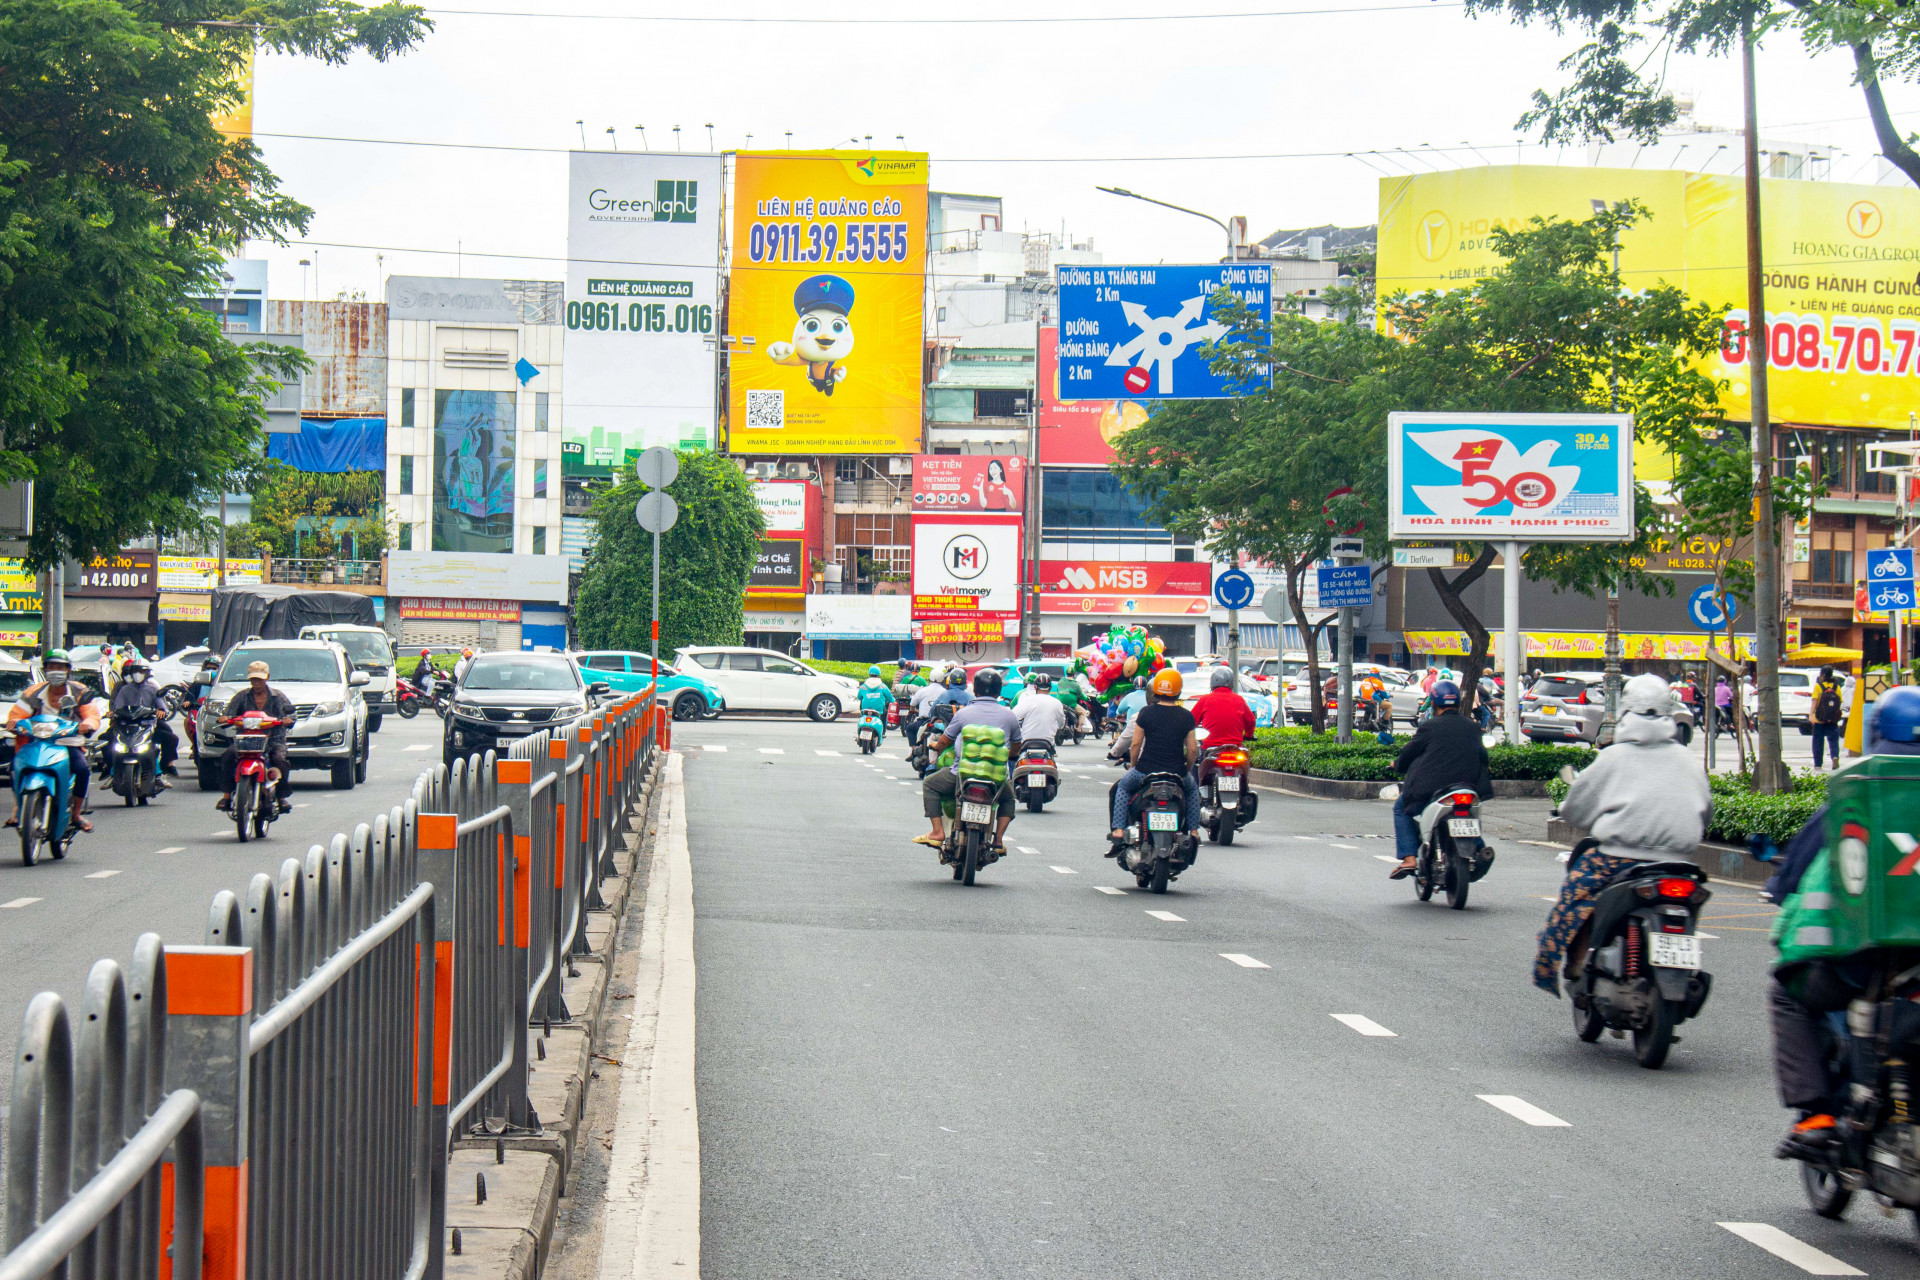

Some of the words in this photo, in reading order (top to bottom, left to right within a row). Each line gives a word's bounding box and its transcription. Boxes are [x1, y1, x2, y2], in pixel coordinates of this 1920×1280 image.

[878, 162, 916, 170] VINAMA
[589, 179, 697, 223] Greenlight
[758, 197, 790, 216] LIÊN
[795, 197, 814, 220] HỆ
[819, 197, 868, 217] QUẢNG
[873, 197, 902, 216] CÁO
[588, 214, 655, 222] ADVERTISING
[750, 223, 908, 263] 0911.39.5555
[1792, 241, 1849, 258] HOANG
[1853, 245, 1879, 260] GIA
[1060, 268, 1091, 286] ĐƯỜNG
[1094, 271, 1106, 286] BA
[1108, 267, 1138, 285] THÁNG
[1140, 270, 1156, 285] HAI
[1221, 266, 1246, 284] CÔNG
[1248, 266, 1269, 284] VIÊN
[1449, 266, 1471, 280] LIÊN
[591, 281, 613, 294] LIÊN
[616, 281, 630, 296] HỆ
[633, 282, 667, 296] QUẢNG
[668, 283, 690, 296] CÁO
[1198, 279, 1203, 294] 1
[1205, 280, 1220, 294] Km
[1816, 273, 1867, 294] HÀNH
[1873, 277, 1920, 297] CÙNG
[1096, 288, 1102, 302] 2
[1104, 287, 1120, 302] Km
[1245, 286, 1264, 304] ĐÀN
[1801, 300, 1828, 312] LIÊN
[1832, 300, 1848, 313] HỆ
[1851, 300, 1894, 315] QUẢNG
[1898, 304, 1920, 317] CÁO
[566, 300, 713, 334] 0961.015.016
[1065, 317, 1100, 336] ĐƯỜNG
[1059, 337, 1085, 357] HỒNG
[1085, 341, 1110, 357] BÀNG
[1722, 318, 1920, 374] 008.70.7
[1069, 366, 1075, 380] 2
[1077, 366, 1092, 380] Km
[1052, 405, 1068, 413] Siêu
[1069, 404, 1080, 413] tốc
[1081, 405, 1090, 413] 24
[1090, 405, 1102, 414] giờ
[806, 439, 827, 447] NGHIỆP
[872, 439, 883, 447] VỰC
[1575, 433, 1610, 444] 30.4
[563, 443, 582, 453] LED
[922, 460, 940, 470] KẸT
[942, 458, 962, 469] TIỀN
[1462, 460, 1557, 509] 50
[1410, 516, 1445, 525] HÒA
[1451, 516, 1493, 526] BÌNH
[1511, 517, 1559, 527] HẠNH
[1564, 517, 1610, 527] PHÚC
[770, 553, 791, 563] Chế
[234, 562, 239, 570] 2
[774, 564, 793, 575] Chế
[91, 572, 139, 588] 42.000
[1099, 569, 1148, 589] MSB
[1332, 568, 1357, 579] CẤM
[939, 585, 992, 597] Vietmoney
[401, 599, 419, 608] CHO
[421, 598, 443, 609] THUÊ
[444, 599, 463, 610] NHÀ
[916, 596, 933, 604] CHO
[934, 595, 954, 604] THUÊ
[955, 594, 973, 604] NHÀ
[416, 610, 424, 618] HỆ
[923, 623, 946, 634] CHO
[949, 621, 977, 633] THUÊ
[979, 622, 1003, 633] NHÀ
[10, 633, 15, 641] 2
[941, 634, 1003, 643] 0903.739.860
